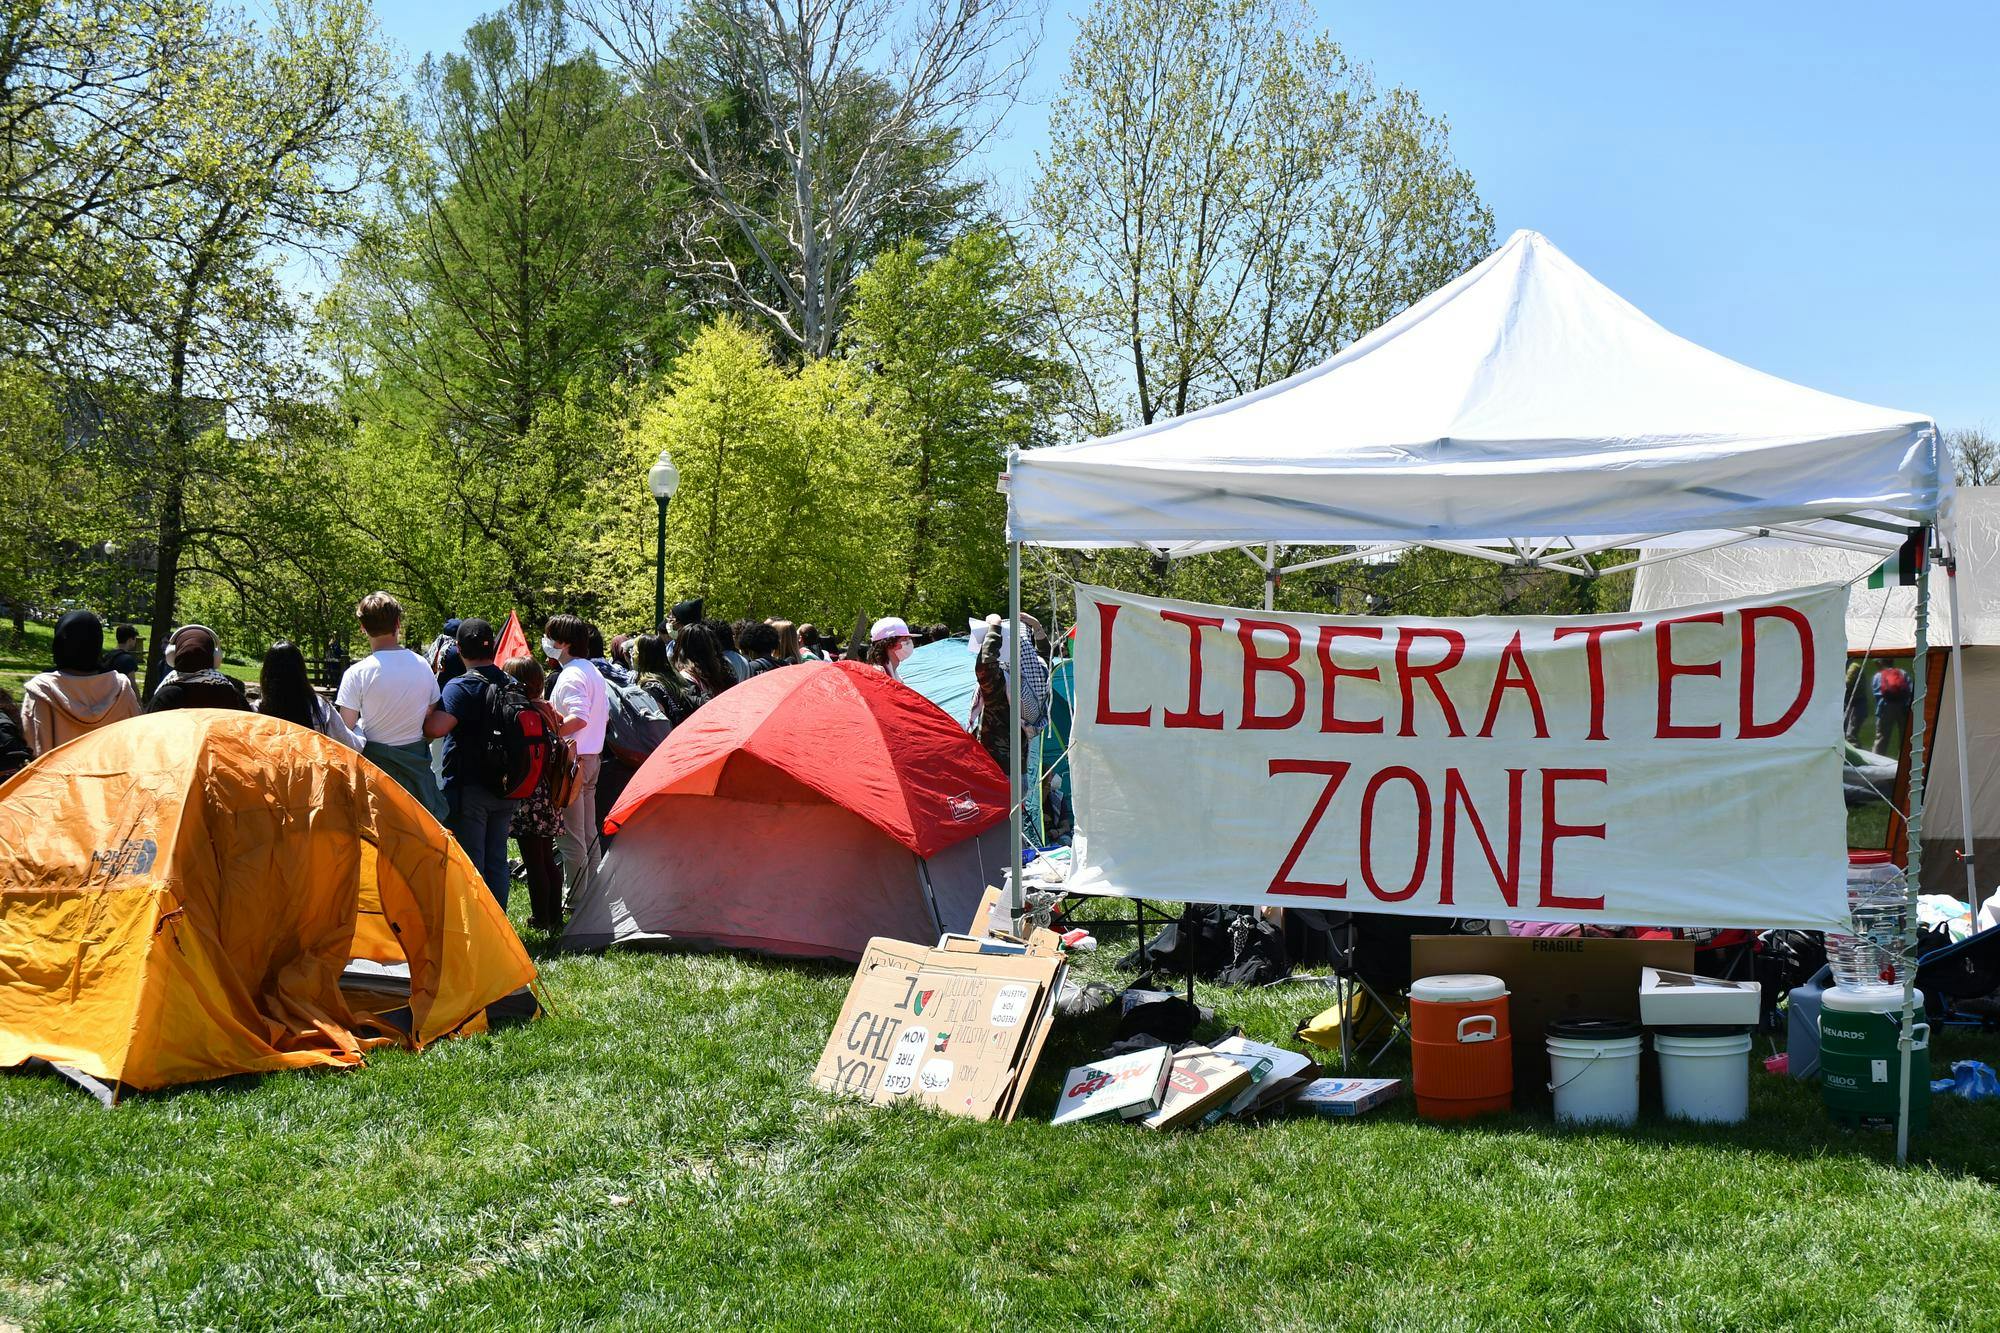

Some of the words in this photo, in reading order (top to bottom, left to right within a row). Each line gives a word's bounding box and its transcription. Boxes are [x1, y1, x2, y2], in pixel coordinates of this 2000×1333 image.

[1095, 602, 1816, 740] LIBERATED
[1266, 759, 1608, 910] ZONE
[1532, 939, 1584, 953] FRAGILE
[999, 989, 1027, 998] PALESTINE
[1002, 1002, 1014, 1010] FOR
[992, 1014, 1018, 1024] FREEDOM
[902, 1031, 926, 1043] NOW
[1823, 1025, 1865, 1040] MENARDS
[896, 1053, 915, 1066] FIRE
[885, 1074, 911, 1088] CEASE
[1827, 1074, 1857, 1086] IGLOO
